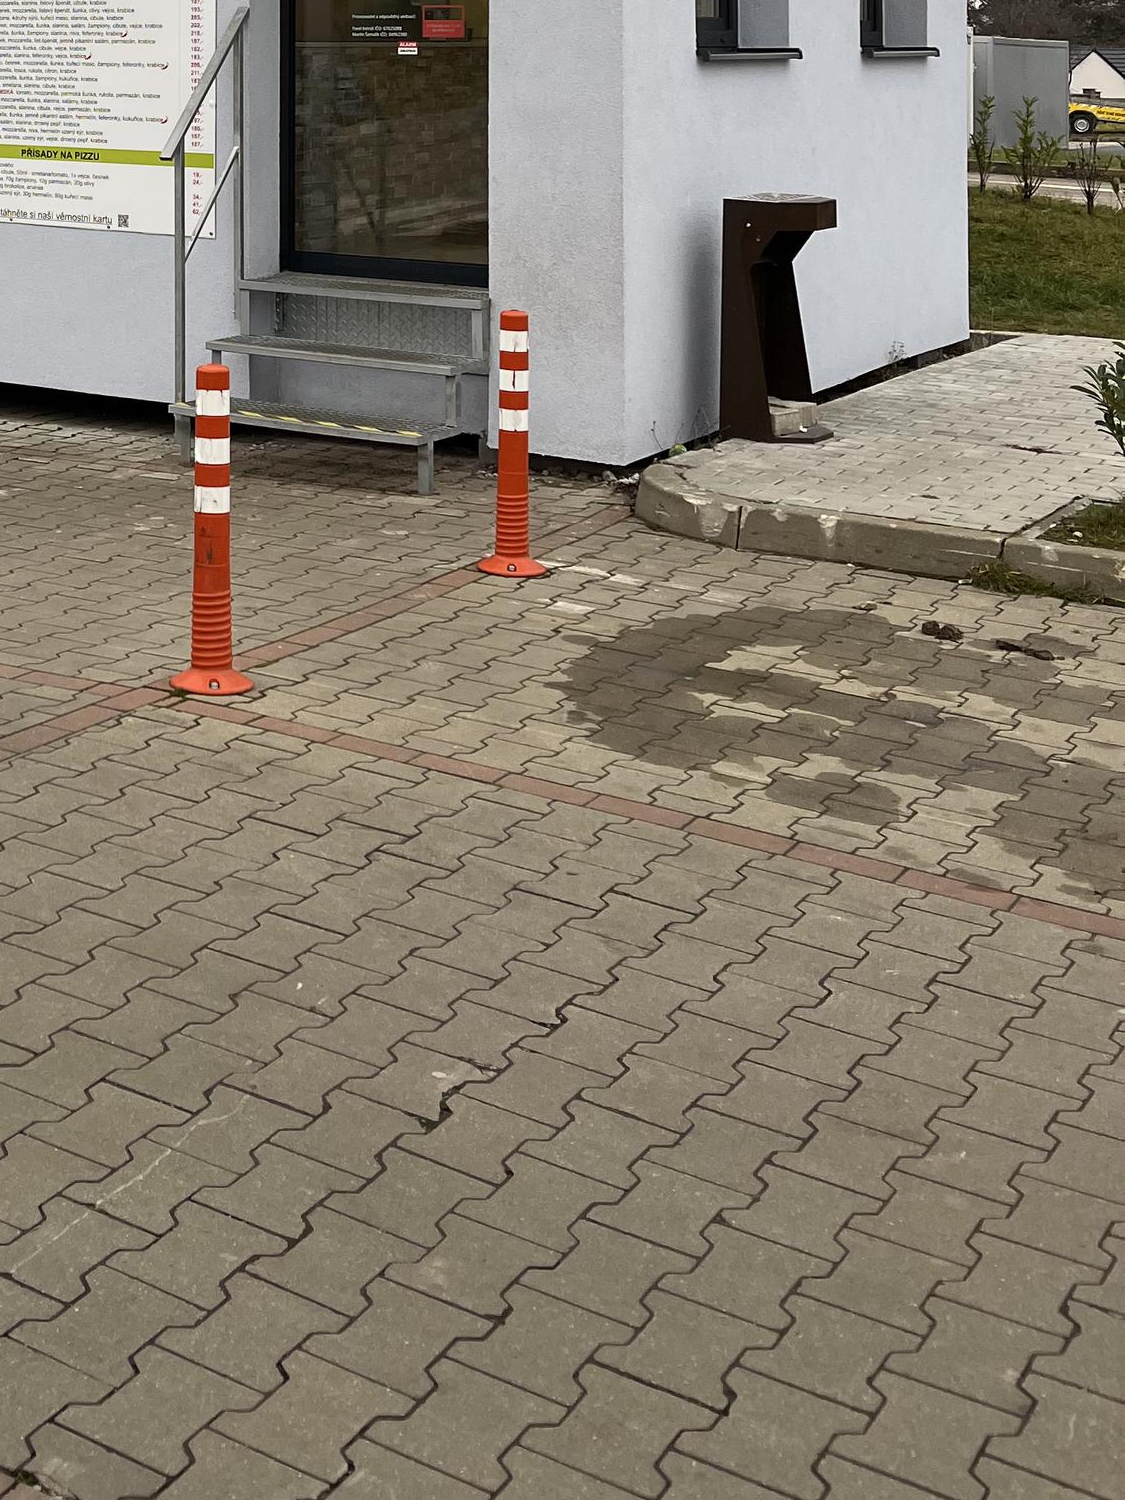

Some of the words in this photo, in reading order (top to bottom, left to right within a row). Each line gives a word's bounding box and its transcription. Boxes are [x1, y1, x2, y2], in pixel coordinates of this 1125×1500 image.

[21, 147, 58, 159] PŘÍSADY
[60, 151, 73, 159] NA
[75, 151, 100, 160] PIZZU
[29, 210, 36, 219] si
[93, 215, 113, 225] kartu
